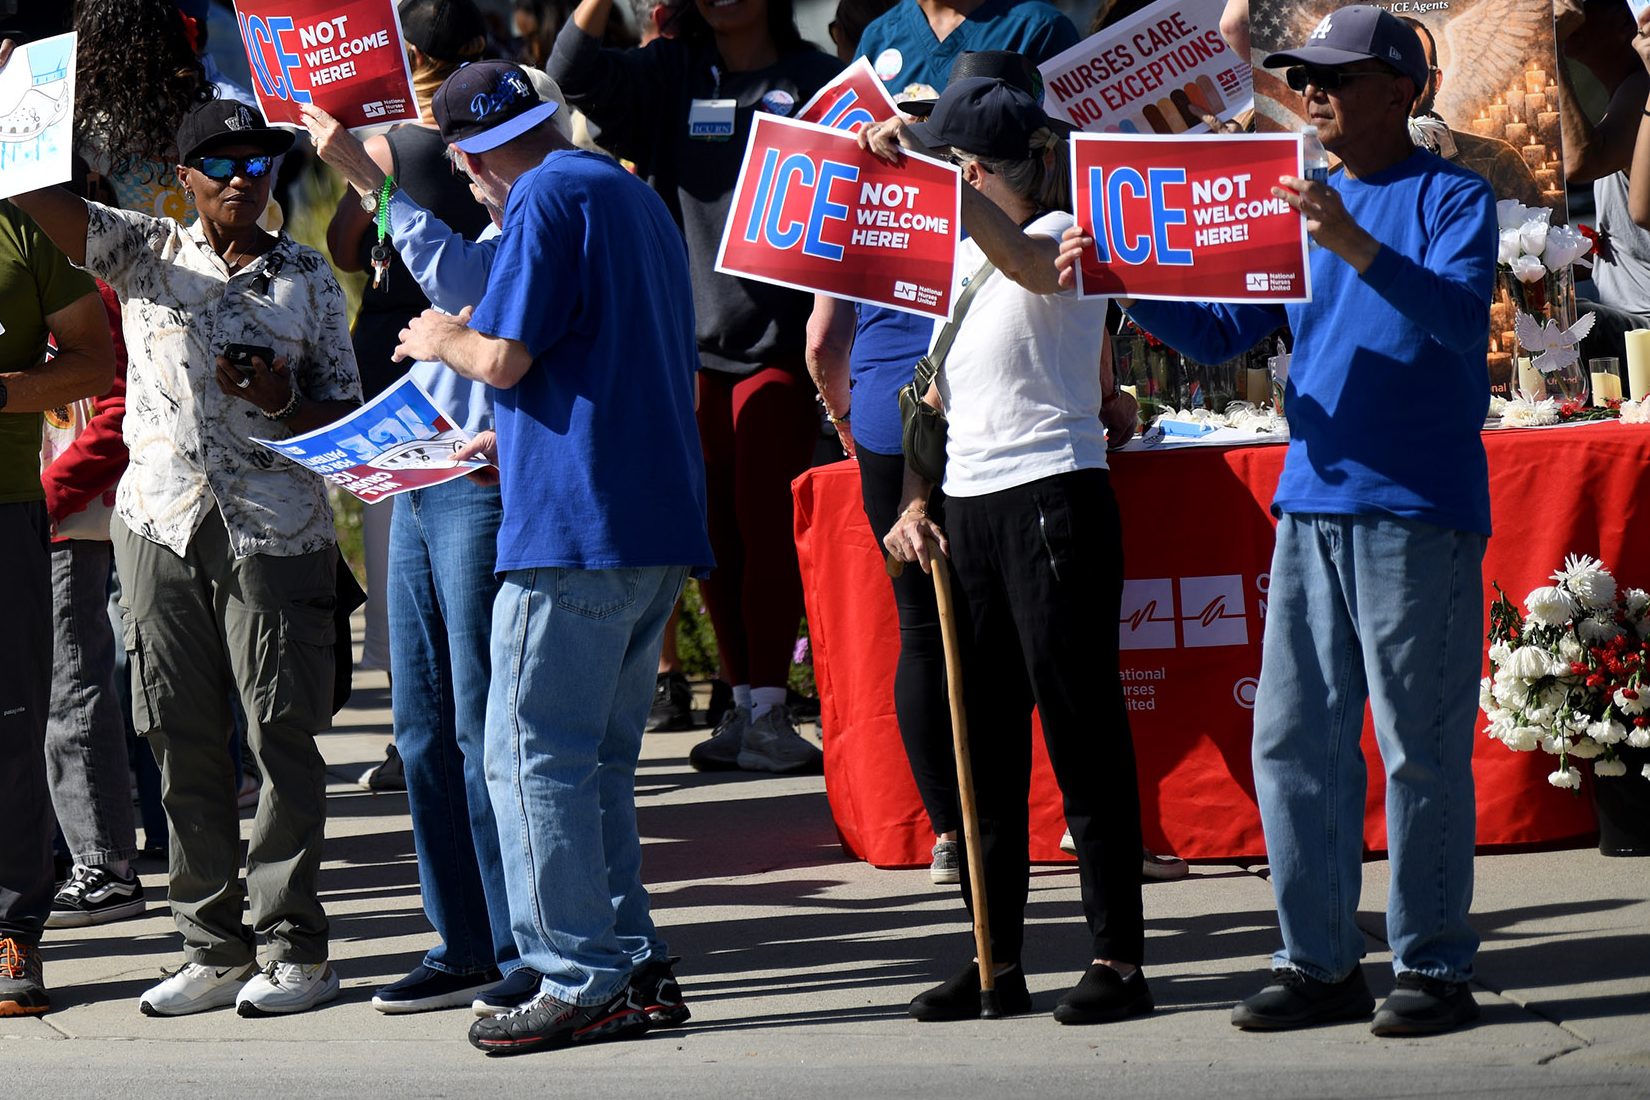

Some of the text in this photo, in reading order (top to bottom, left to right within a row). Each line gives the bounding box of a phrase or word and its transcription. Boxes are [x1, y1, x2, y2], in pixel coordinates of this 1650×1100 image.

[1390, 2, 1410, 13] ICE
[1412, 0, 1449, 14] Agents
[299, 15, 348, 50] NOT
[239, 11, 313, 104] ICE
[304, 29, 390, 68] WELCOME
[1049, 11, 1199, 103] NURSES CARE.
[309, 60, 357, 87] HERE!
[1066, 97, 1103, 128] NO
[1099, 29, 1231, 112] EXCEPTIONS.
[383, 98, 406, 106] National
[715, 124, 731, 134] RN
[859, 182, 920, 209] NOT
[1192, 173, 1252, 205] NOT
[744, 147, 860, 262] ICE
[1088, 166, 1194, 266] ICE
[1193, 198, 1291, 226] WELCOME
[856, 209, 949, 235] WELCOME
[851, 229, 910, 249] HERE!
[1195, 224, 1249, 247] HERE!
[1269, 272, 1296, 280] National
[917, 297, 937, 306] United
[918, 285, 943, 297] National
[918, 291, 938, 301] Nurses
[332, 458, 357, 472] FOR
[359, 480, 403, 495] WILL
[1119, 667, 1166, 681] ational
[555, 1006, 580, 1026] FILA
